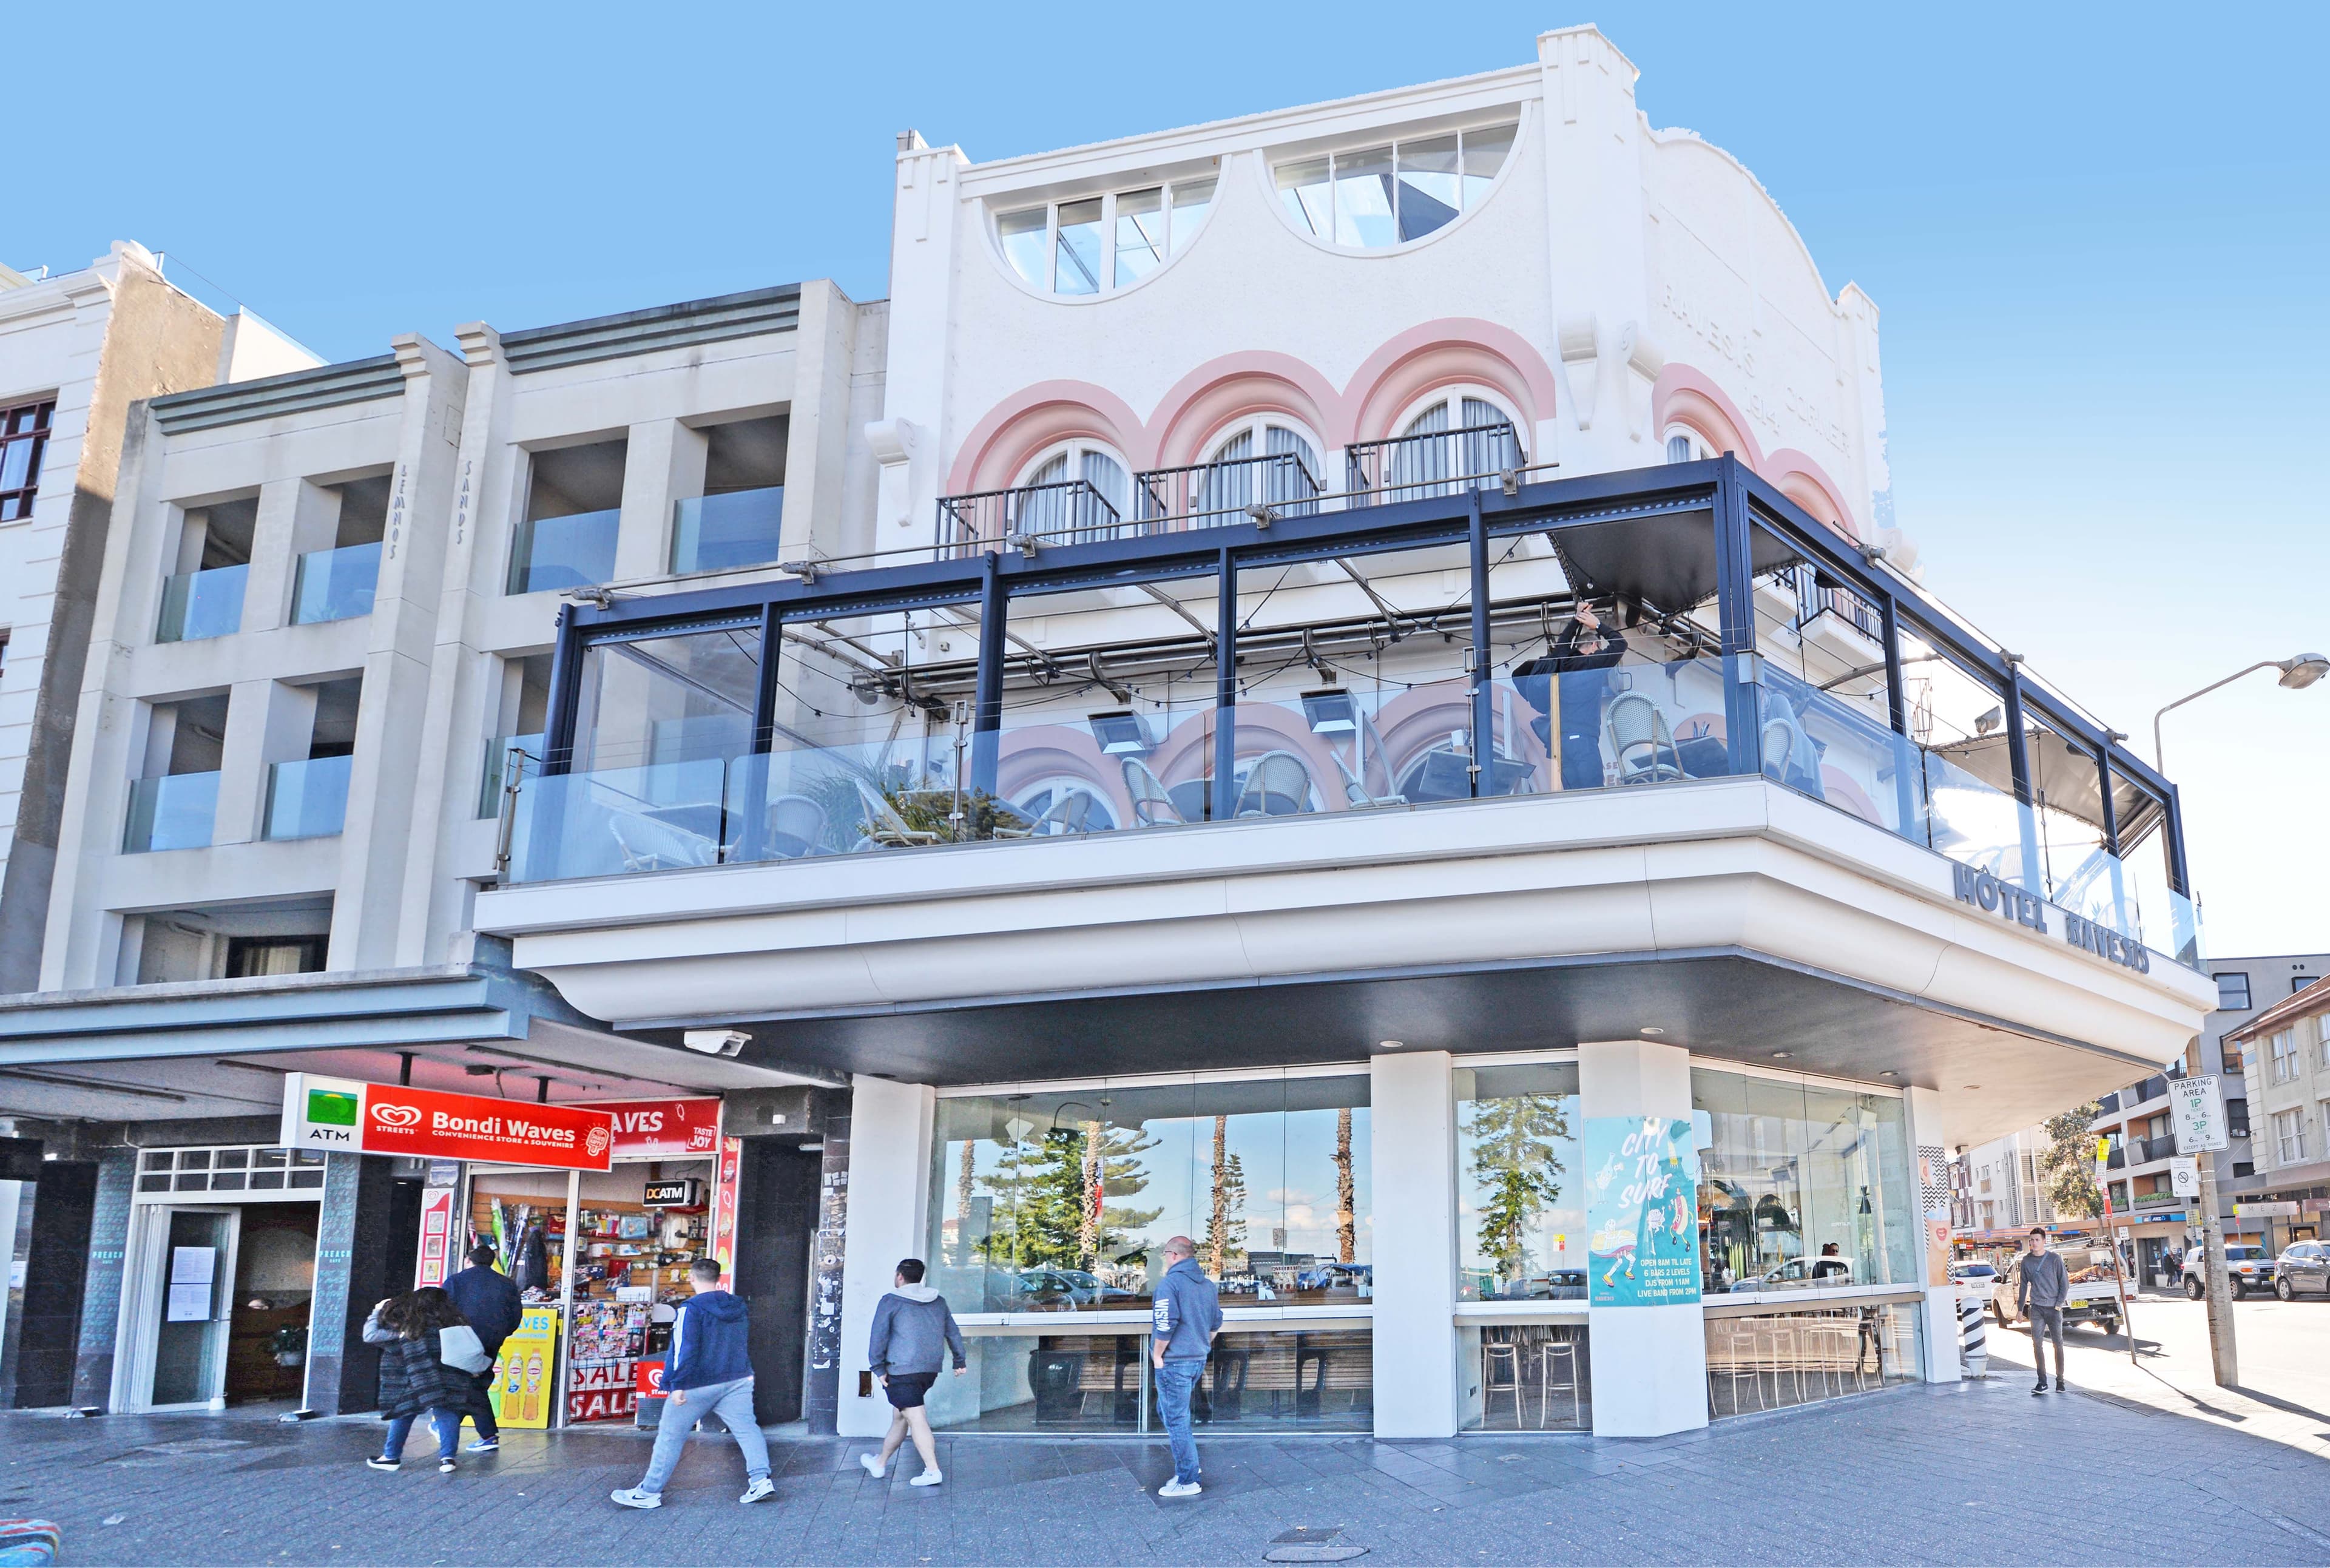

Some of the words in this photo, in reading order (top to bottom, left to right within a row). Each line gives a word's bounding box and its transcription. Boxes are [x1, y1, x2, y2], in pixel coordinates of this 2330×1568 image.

[456, 461, 471, 545] SANDS
[2065, 911, 2150, 975] RAVESIS
[2174, 1078, 2212, 1090] PARKING
[2183, 1087, 2206, 1098] AREA
[2190, 1098, 2201, 1108] 1P
[376, 1125, 414, 1135] STREETS
[432, 1111, 501, 1135] Bondi
[507, 1120, 575, 1142] Waves
[694, 1127, 713, 1137] TASTE
[2193, 1121, 2207, 1130] 3P
[309, 1129, 350, 1141] ATM
[432, 1129, 494, 1141] CONVENIENCE
[531, 1140, 574, 1149] SOUVENIRS
[691, 1137, 712, 1148] JOY
[1635, 1152, 1658, 1179] TO
[1618, 1173, 1672, 1208] SURF
[519, 1316, 549, 1330] VES
[573, 1363, 637, 1385] SALE
[570, 1391, 636, 1417] SALE
